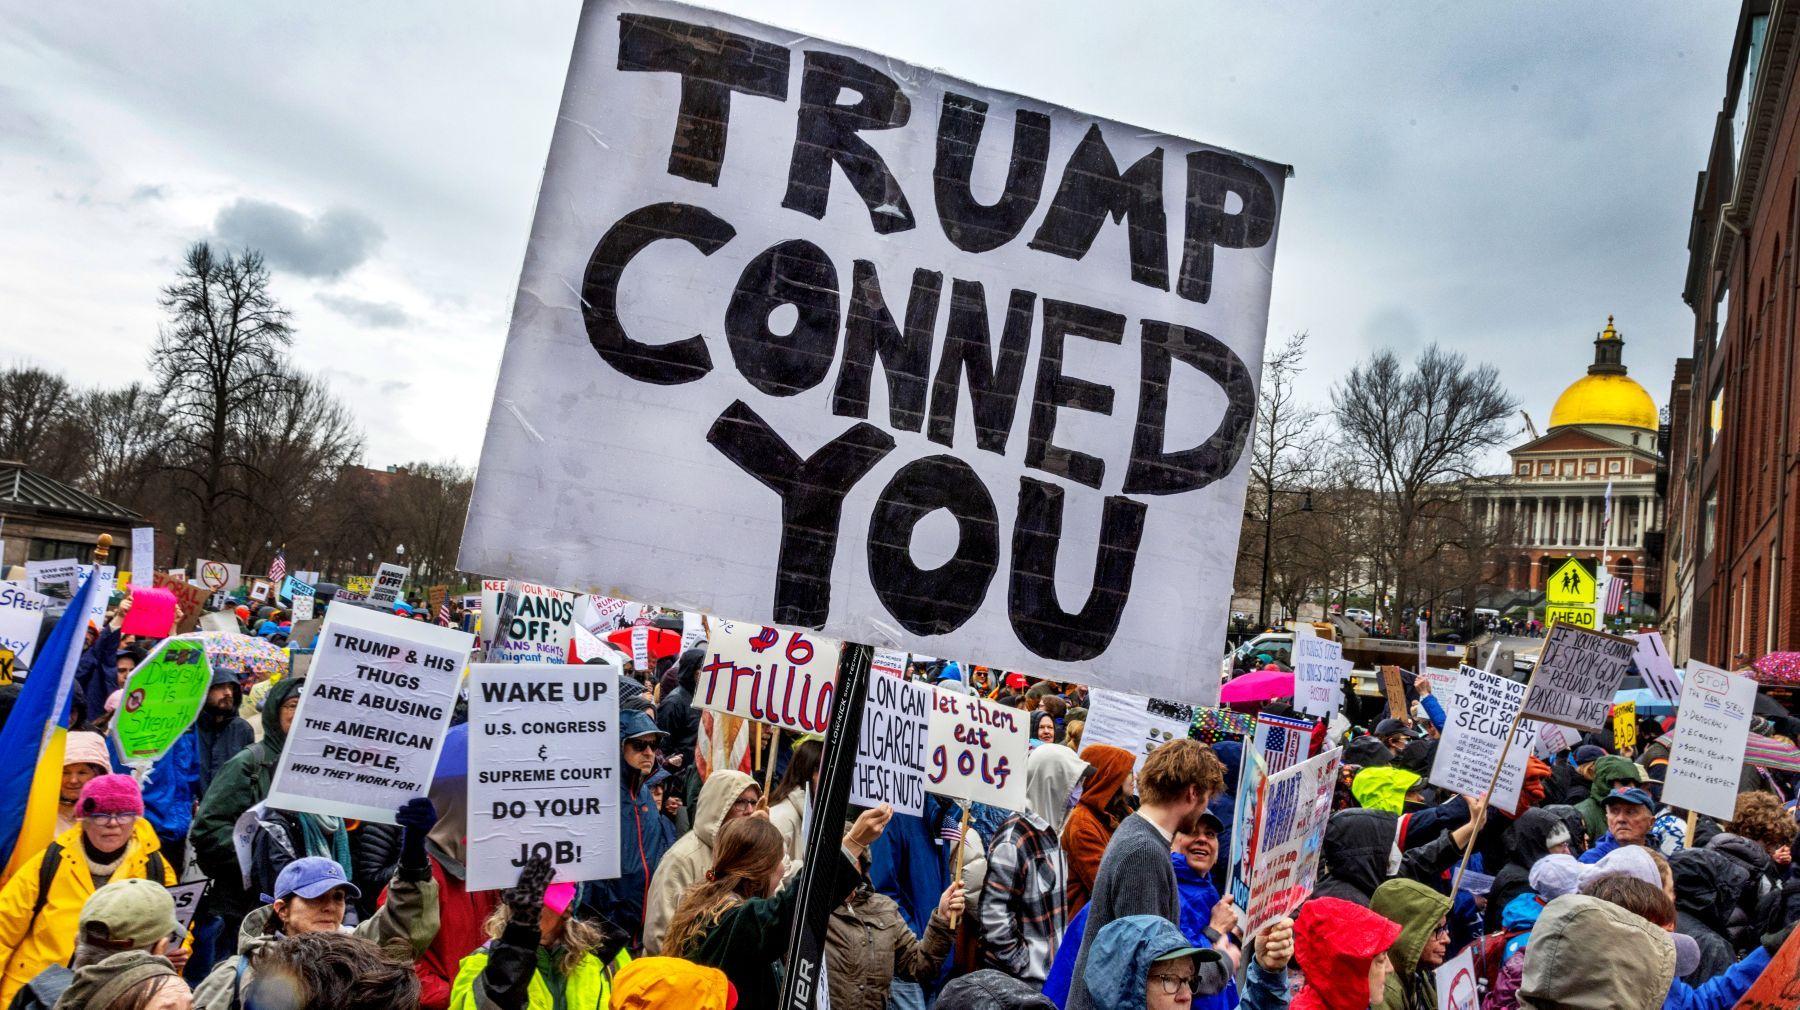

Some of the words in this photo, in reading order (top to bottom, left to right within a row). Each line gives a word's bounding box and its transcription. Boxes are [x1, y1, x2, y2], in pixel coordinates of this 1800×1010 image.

[617, 13, 1276, 304] TRUMP
[581, 201, 1256, 494] CONNED
[707, 399, 1147, 662] YOU
[484, 581, 507, 592] KEE
[1550, 611, 1593, 625] AHEAD
[484, 640, 531, 652] TANS
[536, 643, 565, 657] RIGHTS
[1552, 626, 1574, 642] IF
[333, 633, 400, 660] TRUMP
[405, 650, 418, 665] &
[423, 654, 456, 672] HIS
[356, 665, 421, 690] THUGS
[481, 682, 564, 702] WAKE
[573, 682, 608, 701] UP
[1460, 665, 1476, 678] NO
[1478, 672, 1502, 687] ONE
[1506, 681, 1527, 697] VOT
[1469, 680, 1485, 691] FOR
[1487, 686, 1503, 698] THE
[1549, 670, 1593, 694] REFUND
[1590, 681, 1617, 701] MY
[1695, 671, 1729, 691] STOP
[312, 684, 355, 703] ARE
[357, 693, 443, 721] ABUSING
[703, 654, 834, 733] trillio
[867, 676, 897, 711] LON
[901, 684, 926, 718] CAN
[1454, 693, 1470, 708] TO
[1472, 702, 1498, 718] GUT
[1470, 690, 1488, 702] MAN
[1489, 698, 1500, 706] ON
[1502, 702, 1519, 712] EAR
[1525, 685, 1573, 717] PAYROLL
[1576, 698, 1610, 726] TAXES
[932, 687, 959, 715] let
[966, 699, 1018, 733] them
[304, 718, 332, 732] THE
[333, 720, 434, 751] AMERICAN
[484, 723, 517, 735] U.S.
[521, 721, 607, 735] CONGRESS
[858, 707, 929, 772] LIGARGLE
[953, 723, 992, 749] eat
[1455, 712, 1534, 749] SECURTY
[322, 745, 401, 774] PEOPLE,
[1287, 731, 1298, 767] RESI
[290, 763, 320, 775] WHO
[323, 768, 354, 781] THEY
[355, 773, 390, 788] WORK
[390, 780, 416, 792] FOR
[478, 769, 556, 784] SUPREME
[560, 768, 612, 781] COURT
[928, 744, 1011, 789] golf
[893, 771, 924, 810] NUTS
[492, 801, 527, 820] DO
[534, 798, 601, 818] YOUR
[511, 840, 583, 868] JOB!
